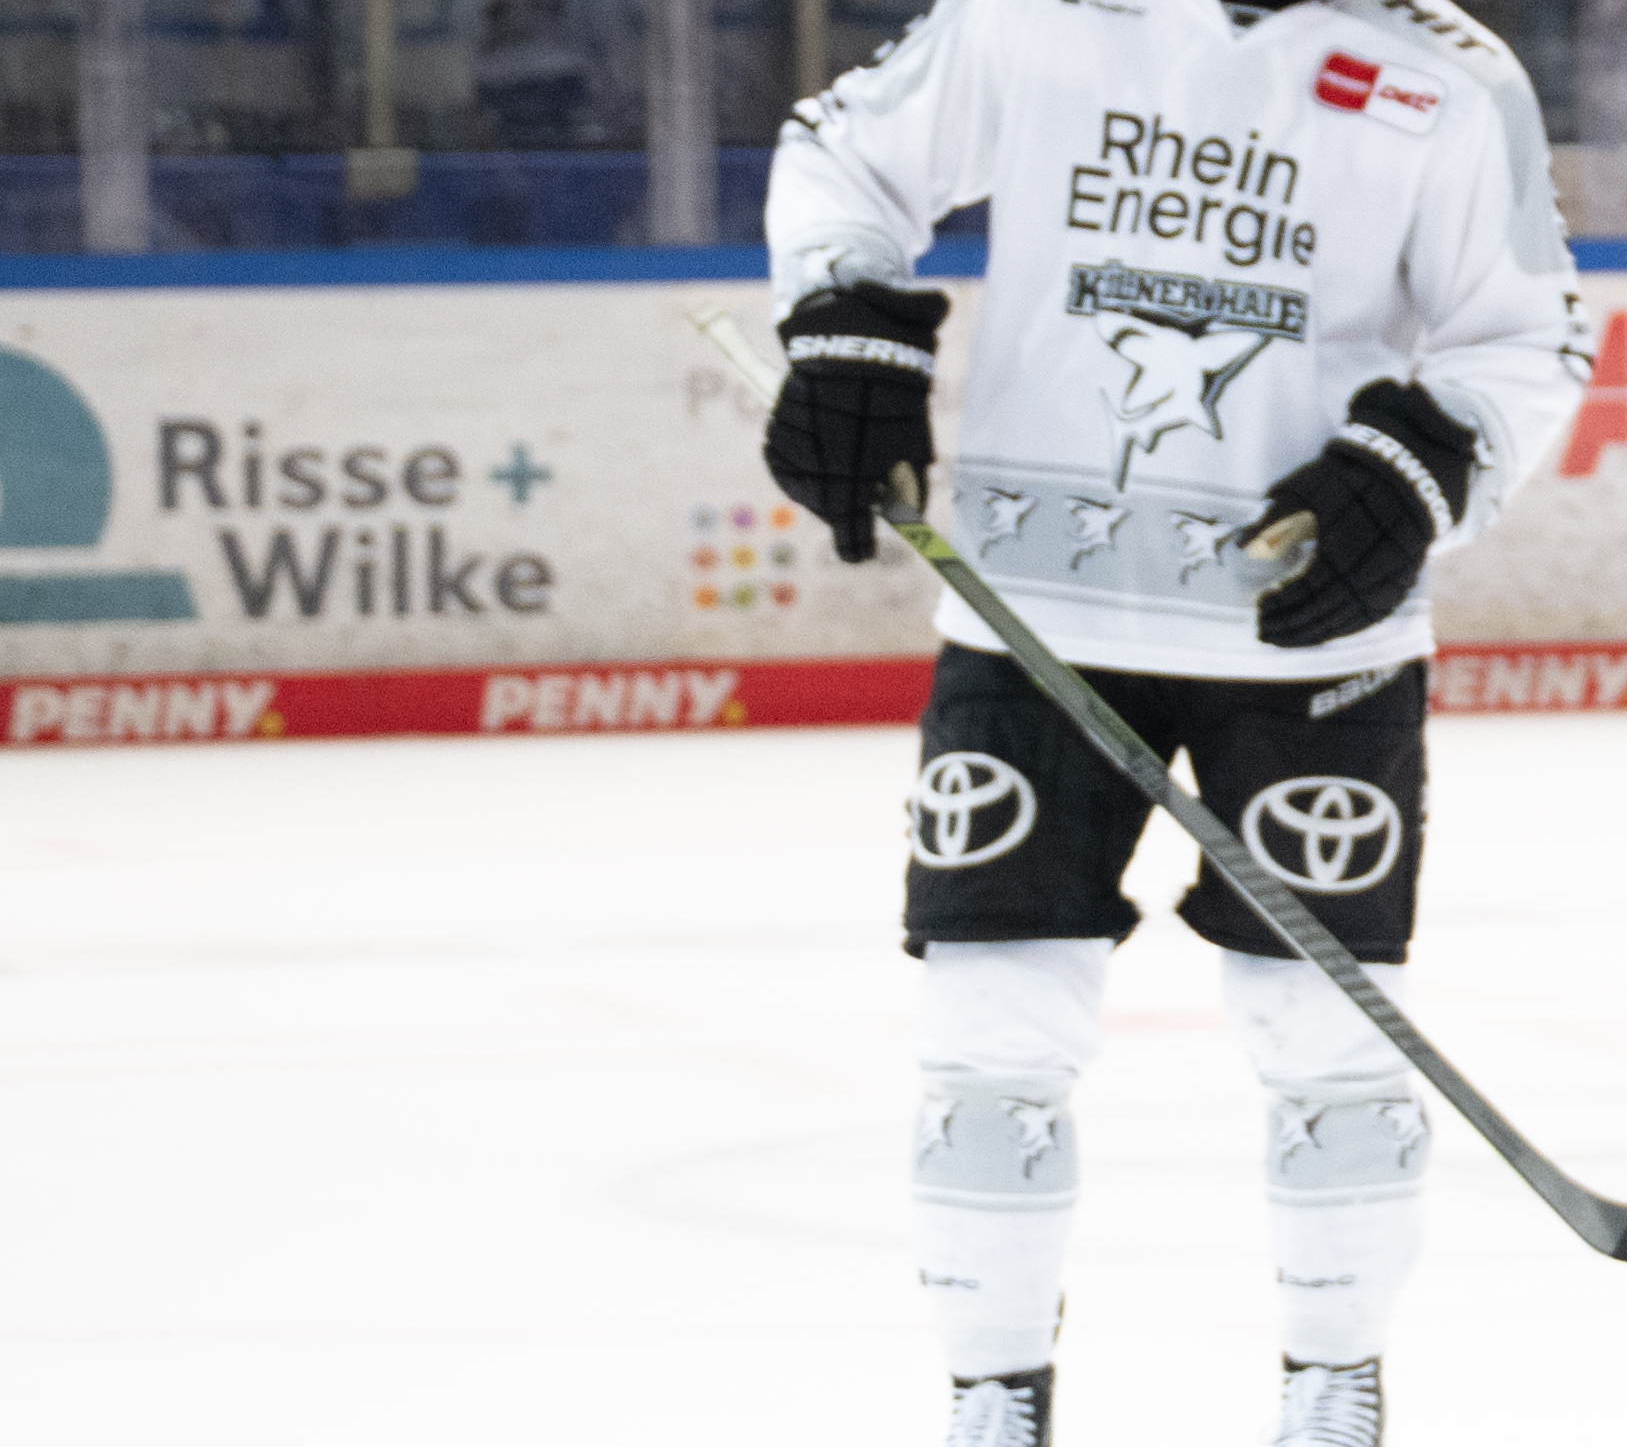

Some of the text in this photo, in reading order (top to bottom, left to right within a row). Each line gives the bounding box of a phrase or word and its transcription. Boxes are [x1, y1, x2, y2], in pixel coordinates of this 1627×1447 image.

[1099, 109, 1300, 206] Rhein
[1066, 163, 1318, 268] Energie
[155, 416, 463, 513] Risse
[218, 522, 557, 620] Wilke
